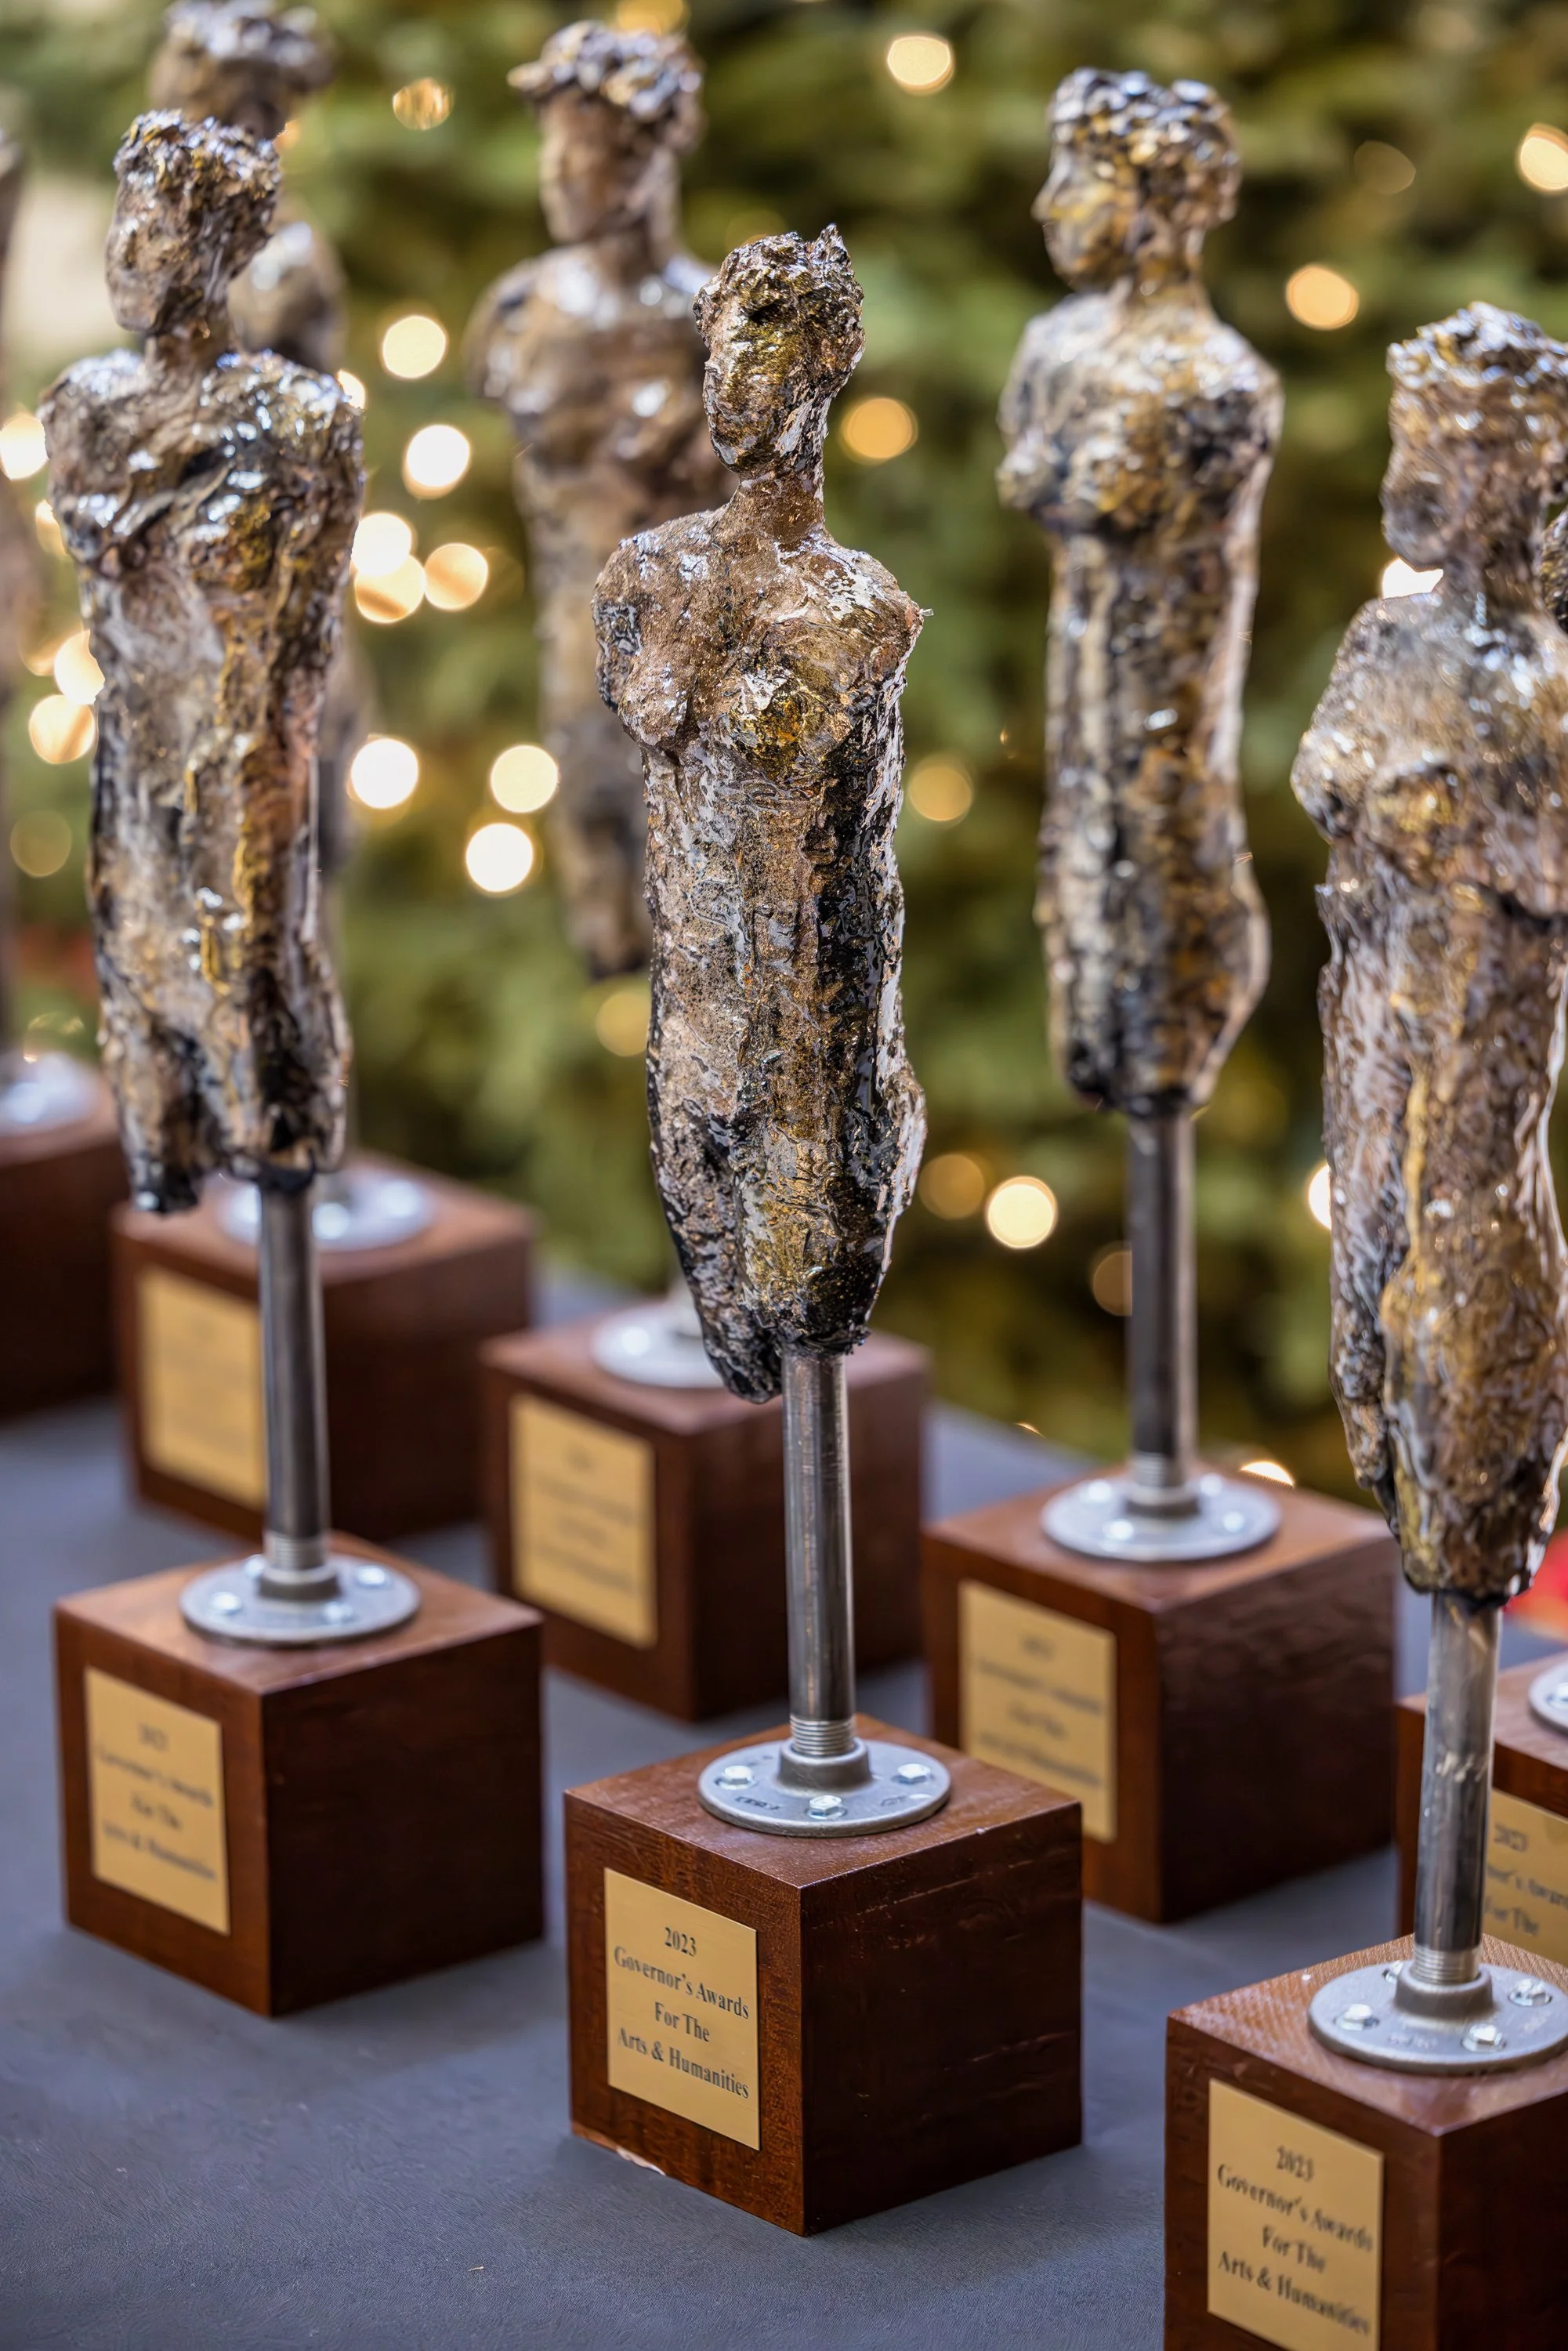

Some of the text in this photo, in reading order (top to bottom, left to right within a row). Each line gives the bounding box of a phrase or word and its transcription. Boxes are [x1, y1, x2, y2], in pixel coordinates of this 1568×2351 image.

[664, 1926, 697, 1957] 2023
[614, 1945, 749, 2020] Governor's Awards
[654, 2001, 710, 2043] For The
[618, 2027, 748, 2099] Arts & Humanities
[1218, 2164, 1308, 2222] Governor's
[1219, 2251, 1253, 2282] Arts
[1257, 2266, 1272, 2291] &
[1262, 2224, 1326, 2273] For The
